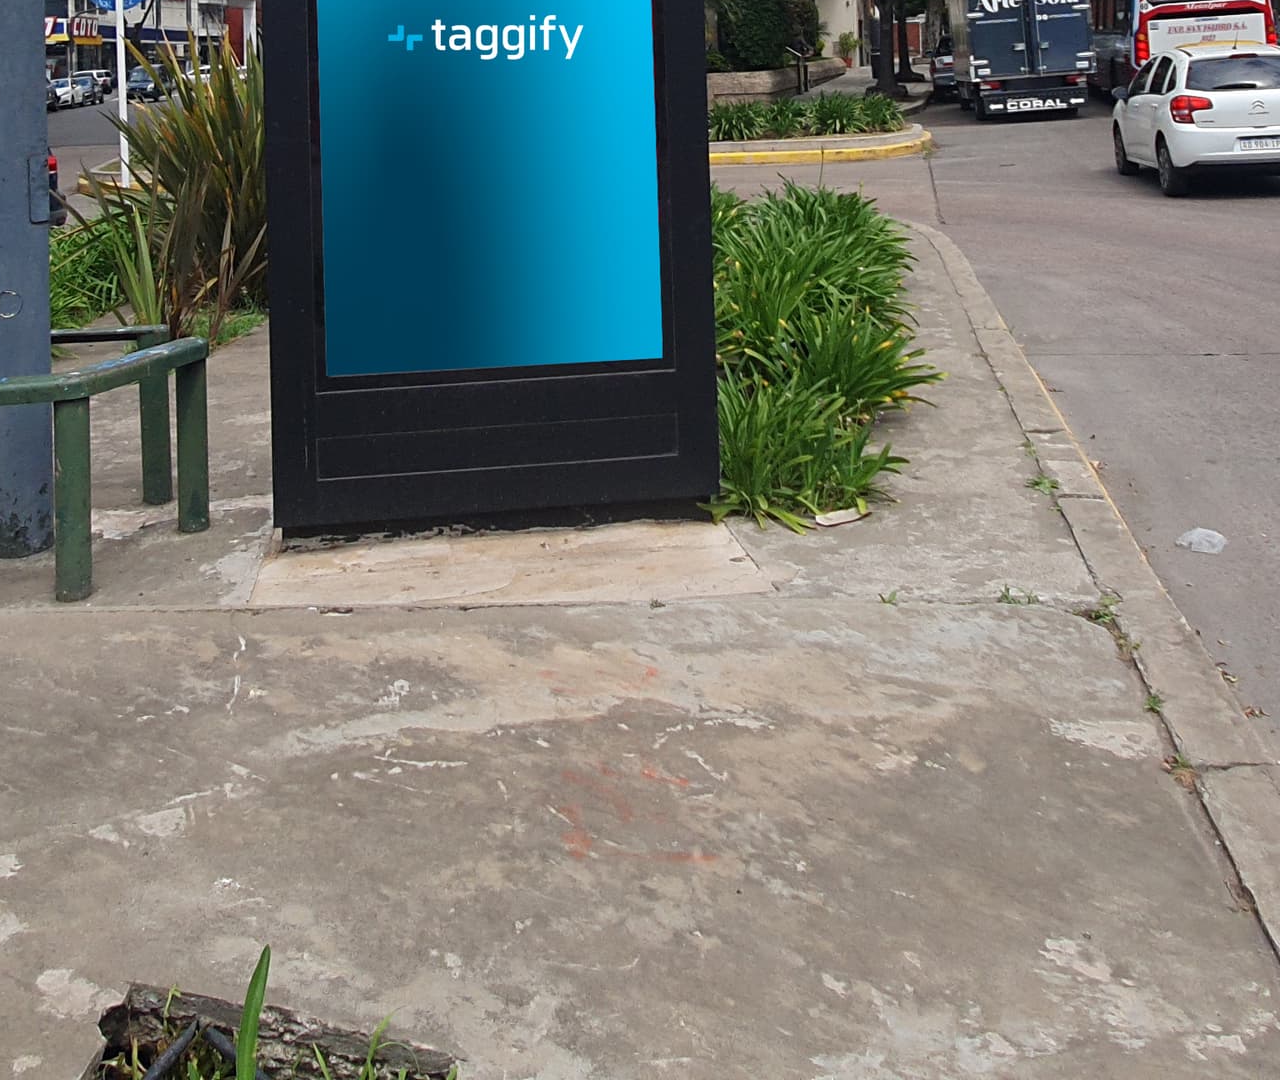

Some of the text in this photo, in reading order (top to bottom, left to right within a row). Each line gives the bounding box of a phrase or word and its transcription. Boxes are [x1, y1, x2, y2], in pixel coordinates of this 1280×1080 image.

[73, 17, 98, 37] COTO
[431, 14, 584, 60] taggify
[1006, 98, 1067, 111] CORAL
